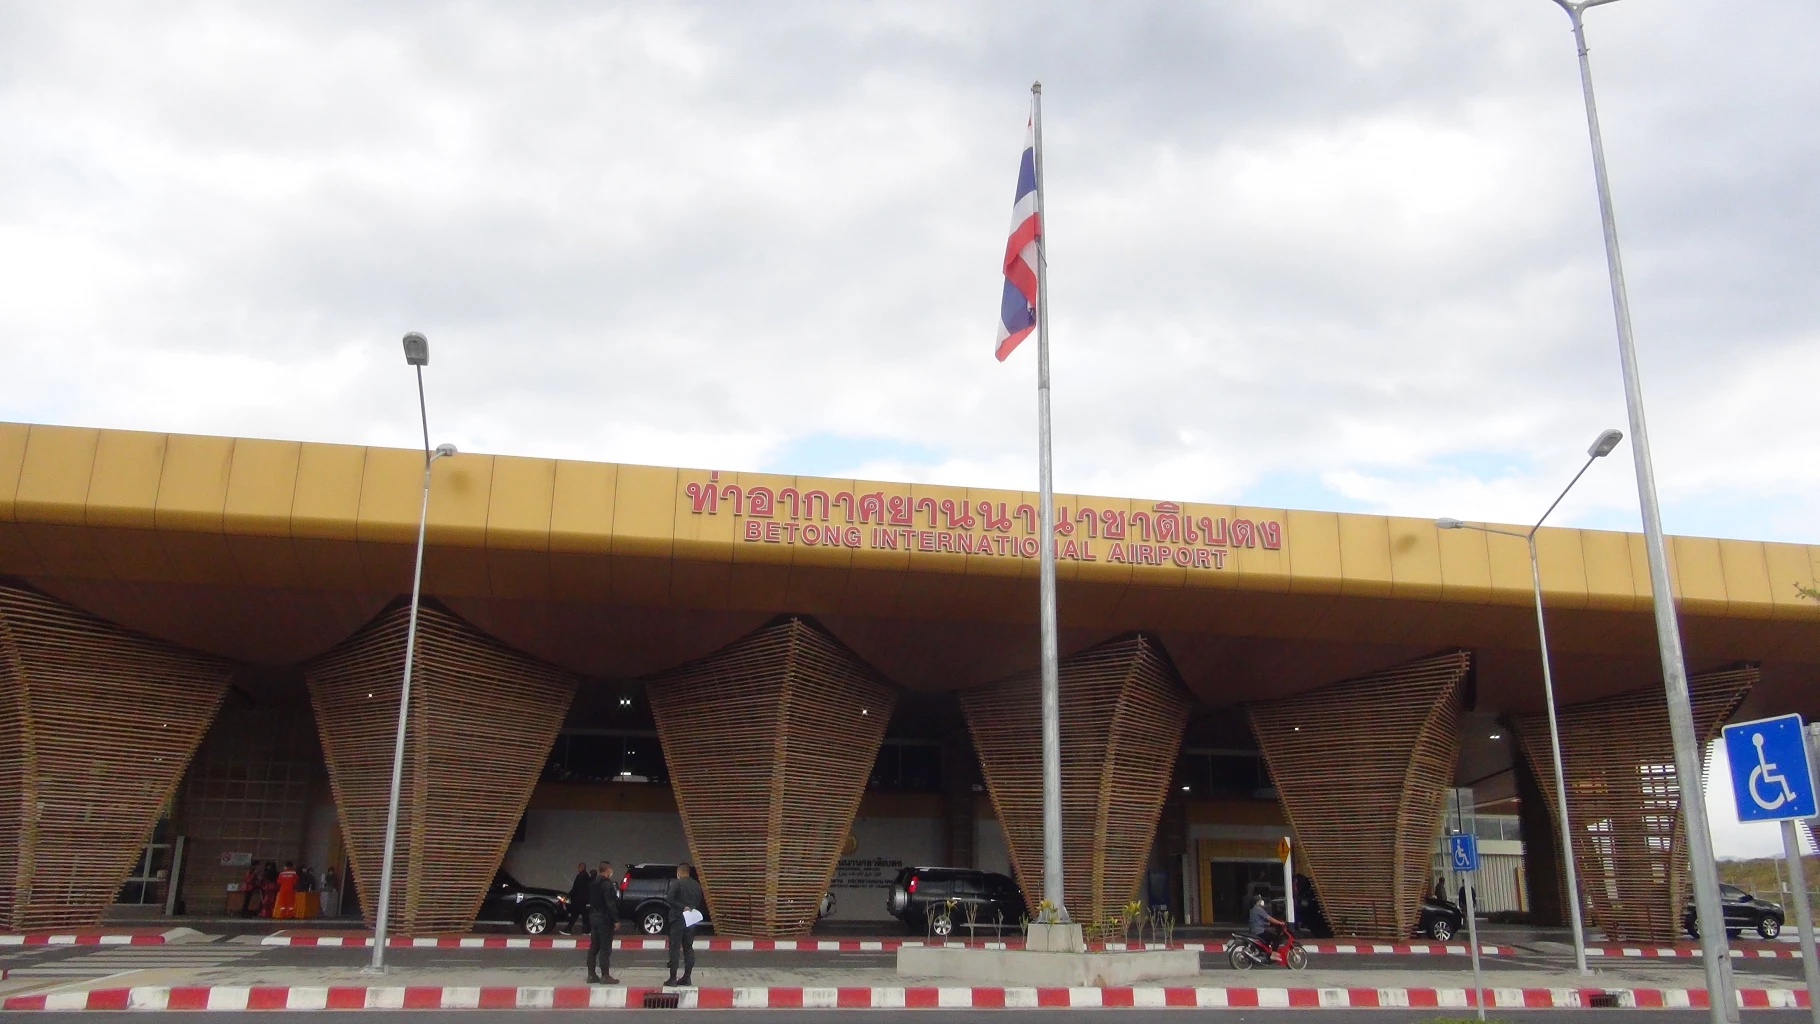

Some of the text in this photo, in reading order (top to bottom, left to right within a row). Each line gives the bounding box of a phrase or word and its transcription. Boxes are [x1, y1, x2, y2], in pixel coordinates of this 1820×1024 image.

[745, 520, 1228, 568] BETONG INTERNATIOAL AIRPORT
